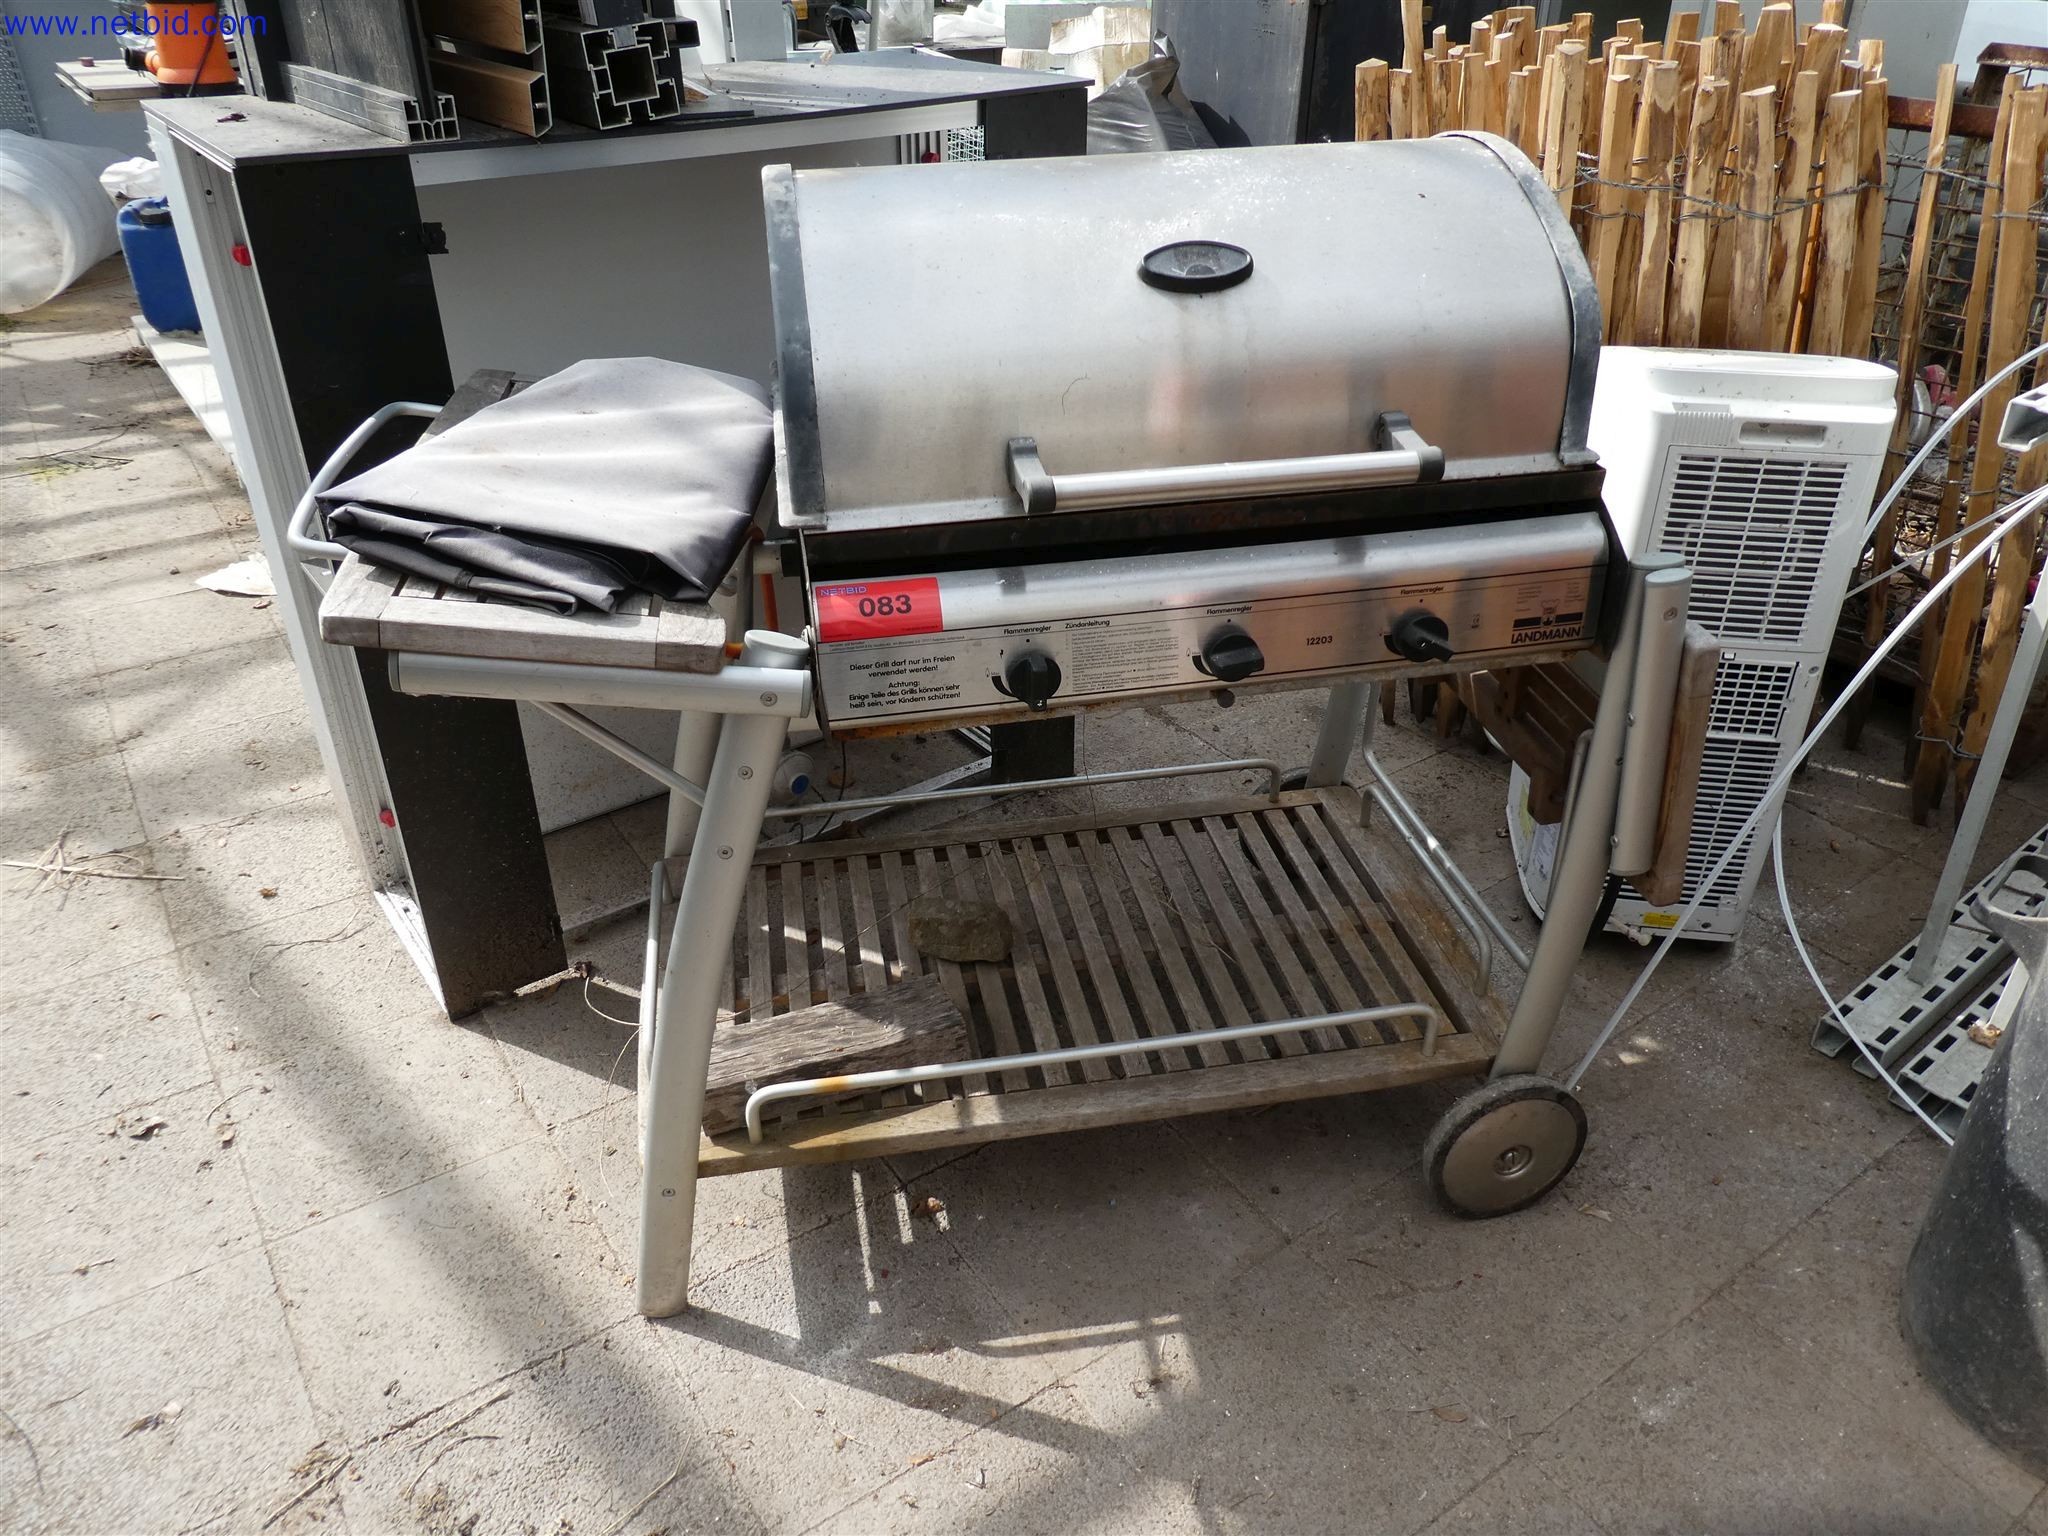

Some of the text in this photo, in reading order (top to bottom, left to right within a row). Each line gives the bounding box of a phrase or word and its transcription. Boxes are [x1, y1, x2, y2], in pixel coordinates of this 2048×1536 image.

[820, 585, 867, 596] NETBID
[858, 594, 912, 617] 083
[1206, 605, 1253, 615] Flammenregler
[1003, 625, 1052, 635] Flammenregler
[1511, 627, 1581, 645] LANDMANN
[1306, 635, 1333, 646] 12203
[849, 663, 873, 671] Dieser
[874, 660, 890, 669] Grill
[891, 659, 907, 667] darf
[908, 658, 921, 666] nur
[933, 655, 955, 663] Freien
[868, 665, 939, 678] verwendet werden!
[888, 680, 921, 689] Achtung:
[848, 692, 870, 702] Einige
[871, 690, 886, 699] Teile
[887, 688, 900, 697] des
[900, 687, 917, 696] Grills
[918, 683, 945, 693] können
[849, 701, 866, 709] heiß
[898, 695, 926, 704] Kindern
[927, 691, 961, 701] schützen!
